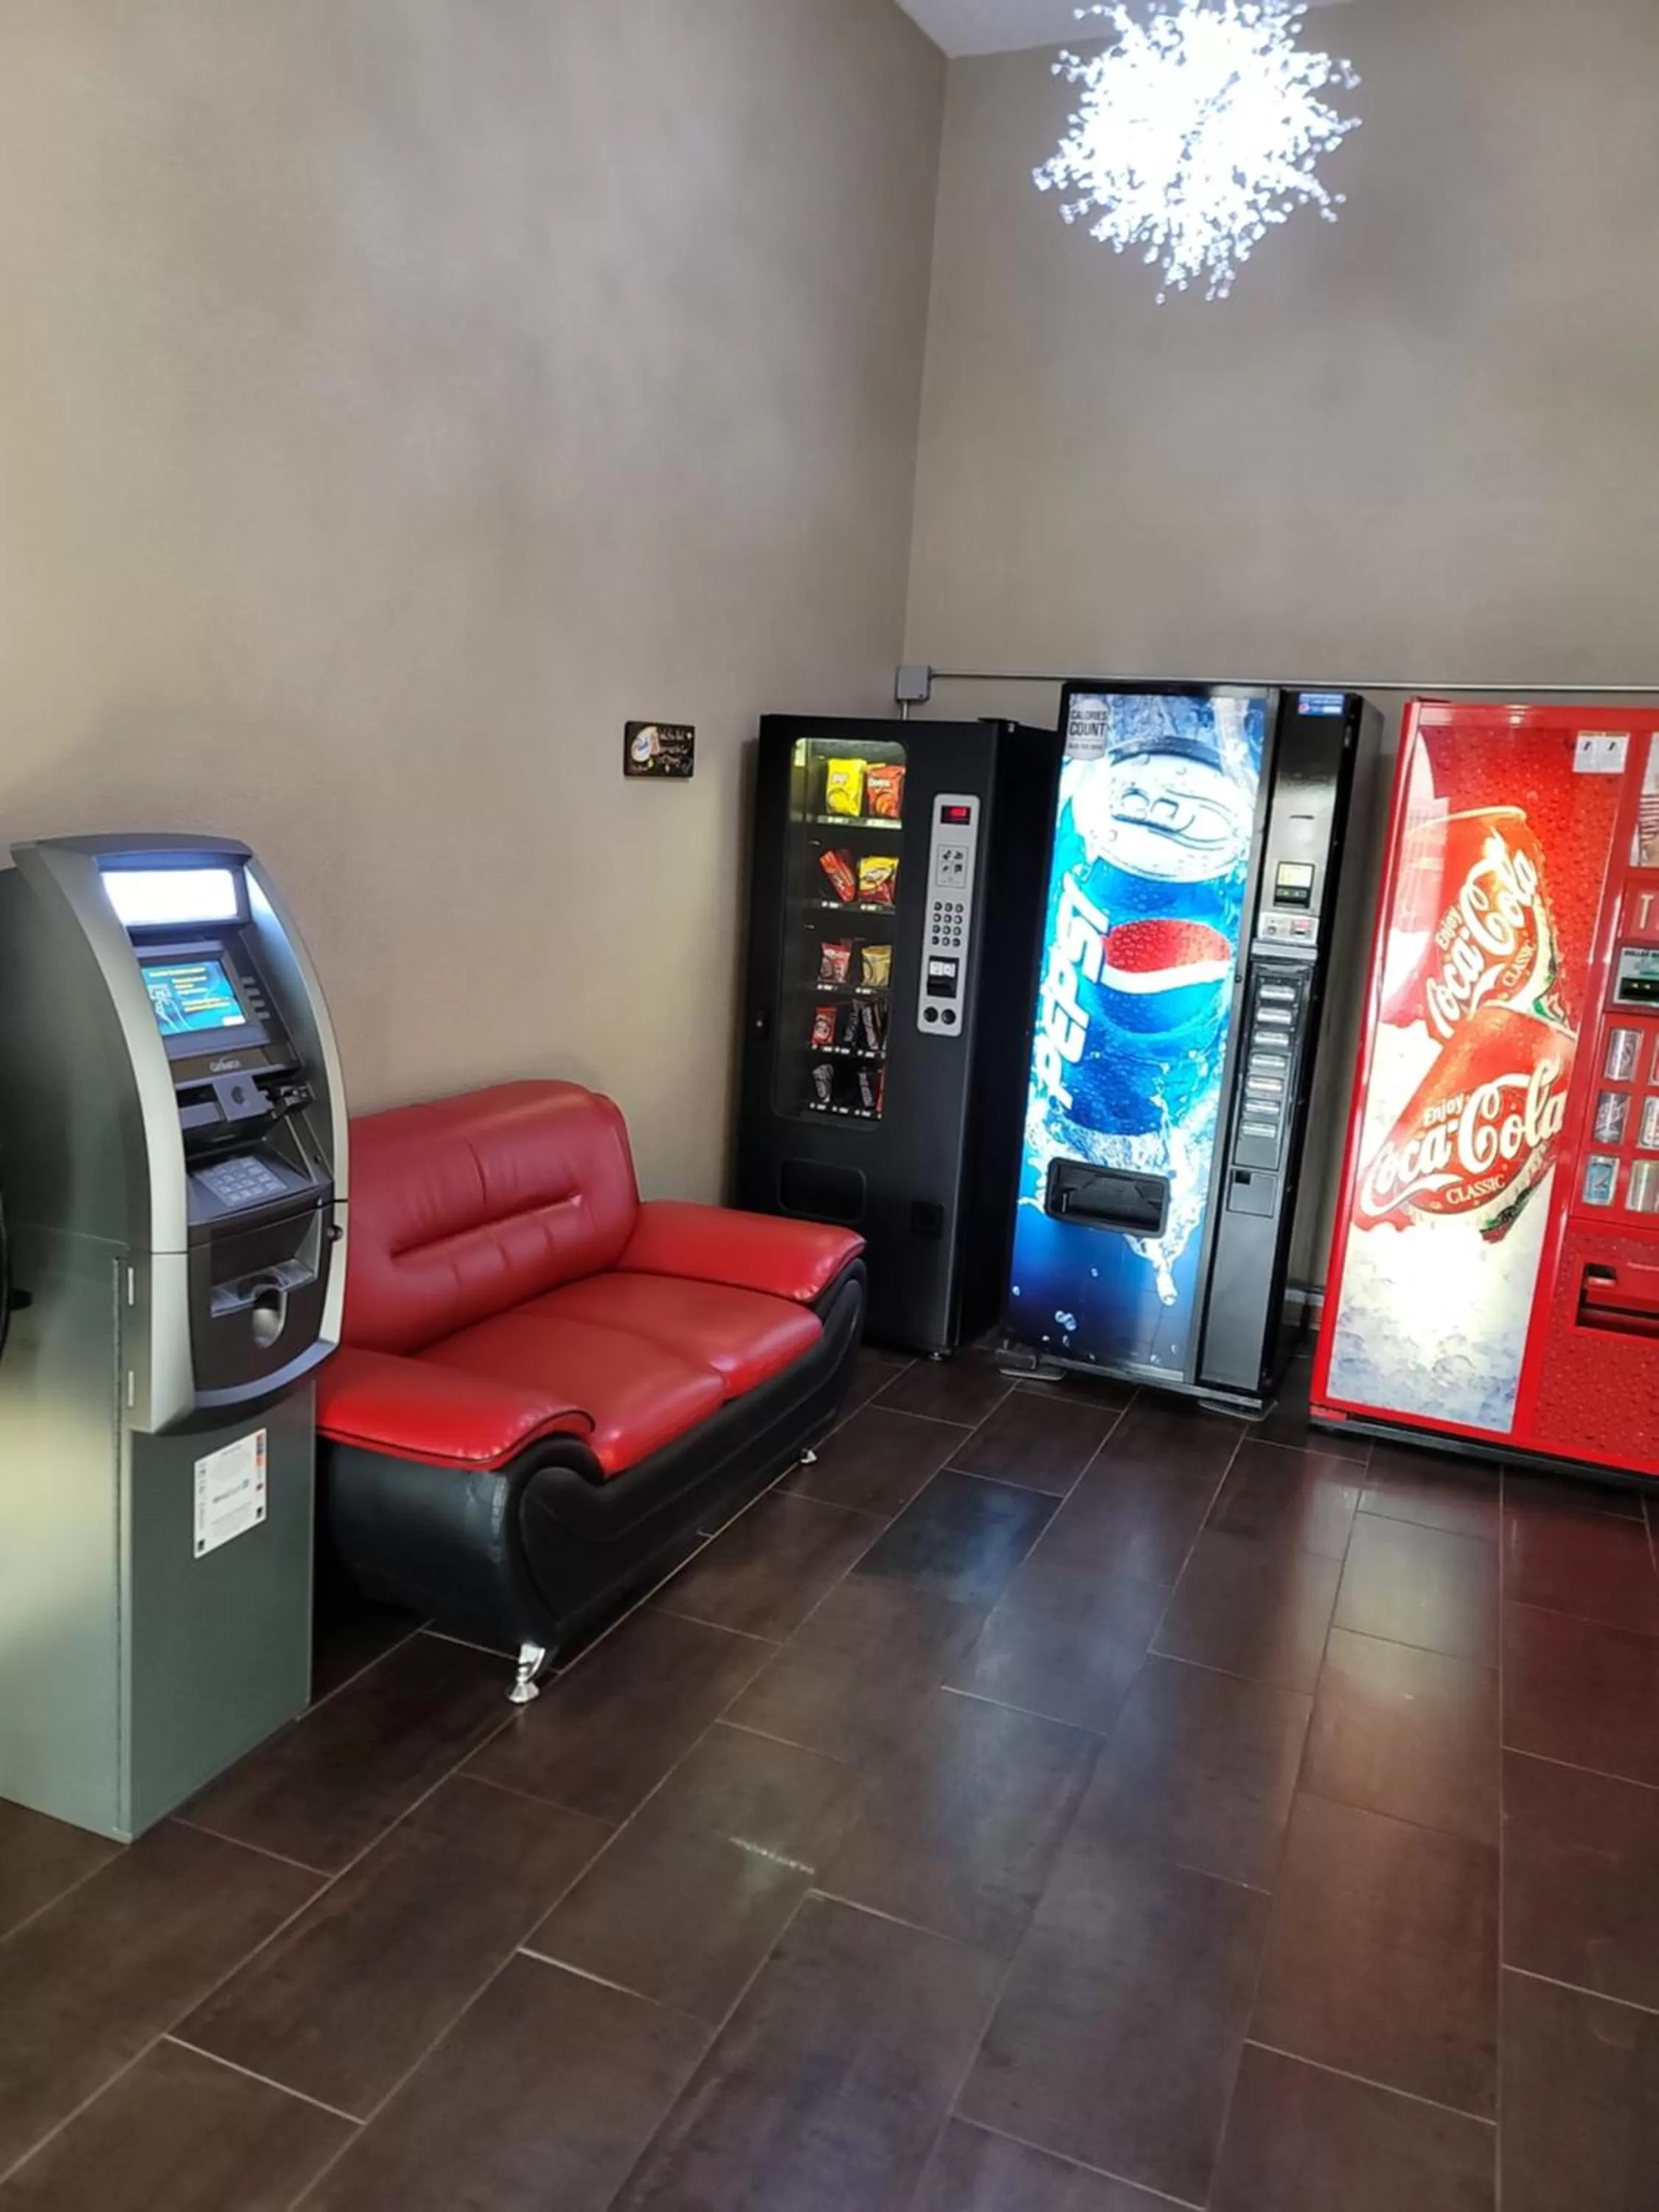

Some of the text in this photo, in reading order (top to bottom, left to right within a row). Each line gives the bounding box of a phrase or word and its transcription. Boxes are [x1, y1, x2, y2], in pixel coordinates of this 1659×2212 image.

[1069, 722, 1107, 736] COUNT
[1426, 826, 1537, 1038] Coca-Cola
[1435, 905, 1463, 951] Enjoy
[1502, 938, 1536, 988] CLASSIC
[1034, 870, 1110, 1110] PEPSI
[1423, 1093, 1465, 1125] Enjoy
[1360, 1056, 1568, 1216] Coca-Cola
[1445, 1174, 1506, 1205] CLASSIC
